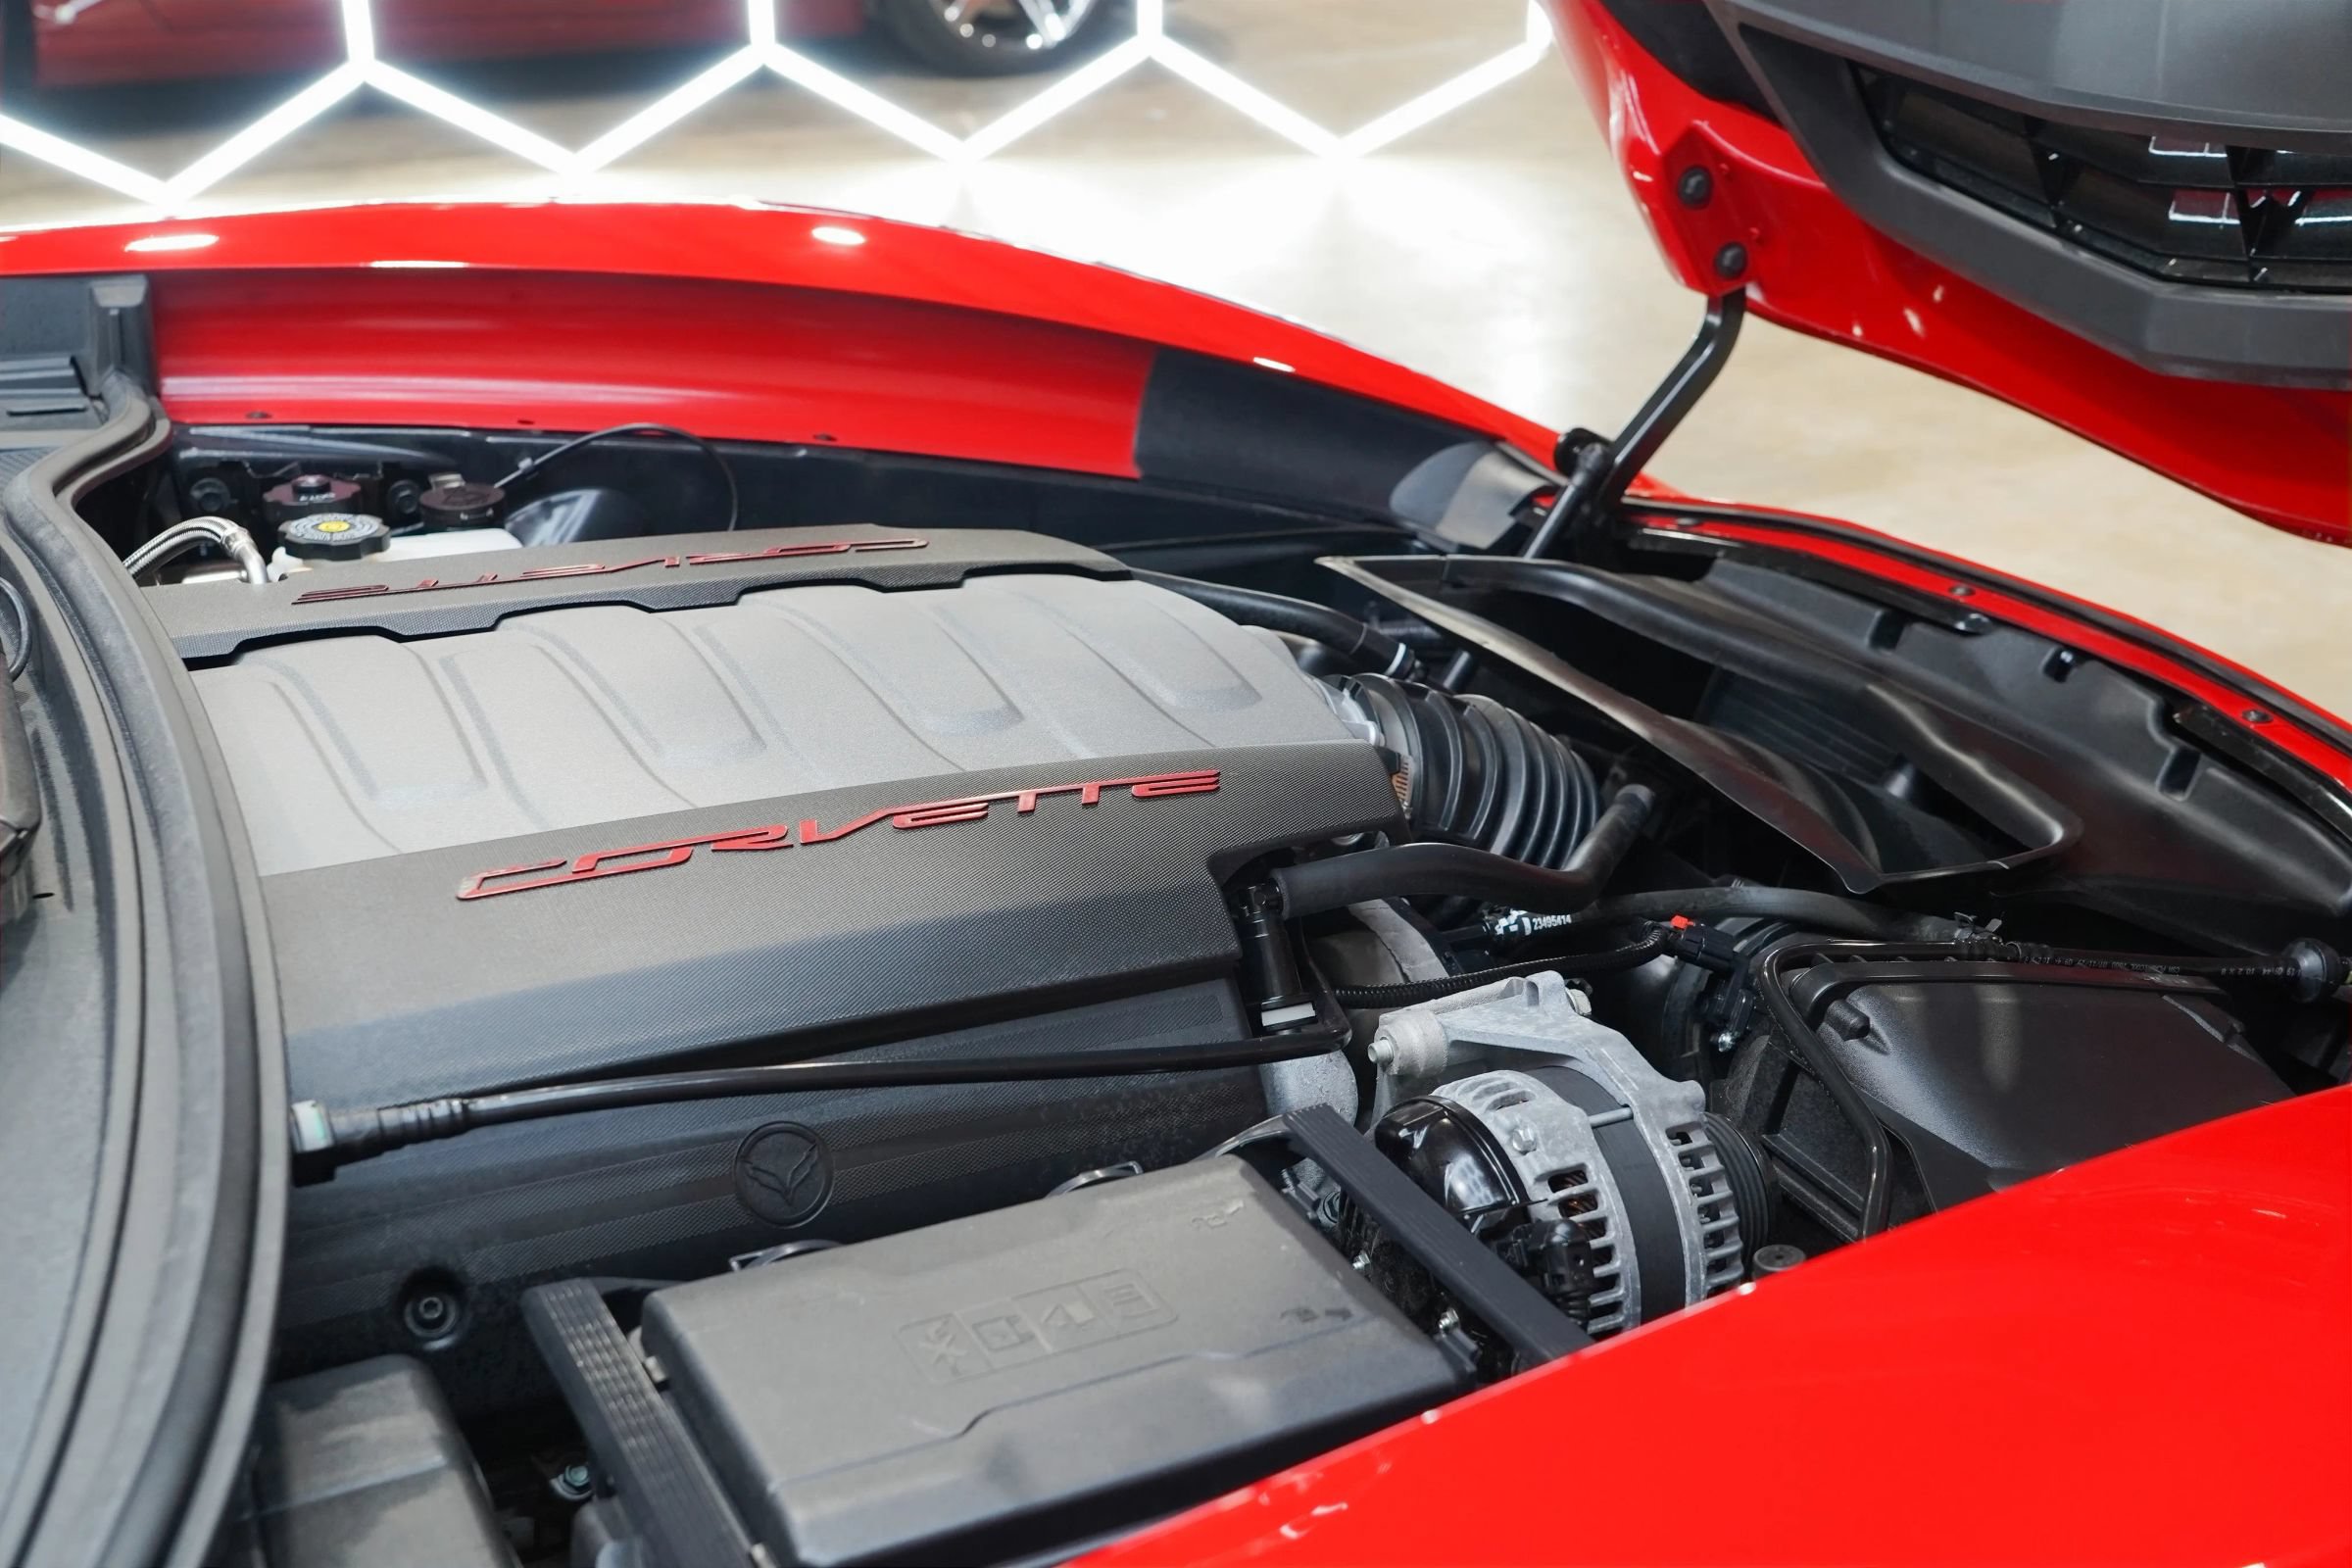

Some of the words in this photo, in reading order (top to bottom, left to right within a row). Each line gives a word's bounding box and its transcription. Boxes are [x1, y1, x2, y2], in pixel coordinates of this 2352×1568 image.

[289, 536, 930, 605] CORVETTE
[456, 769, 1221, 901] CORVETTE
[1532, 913, 1572, 931] 23495414
